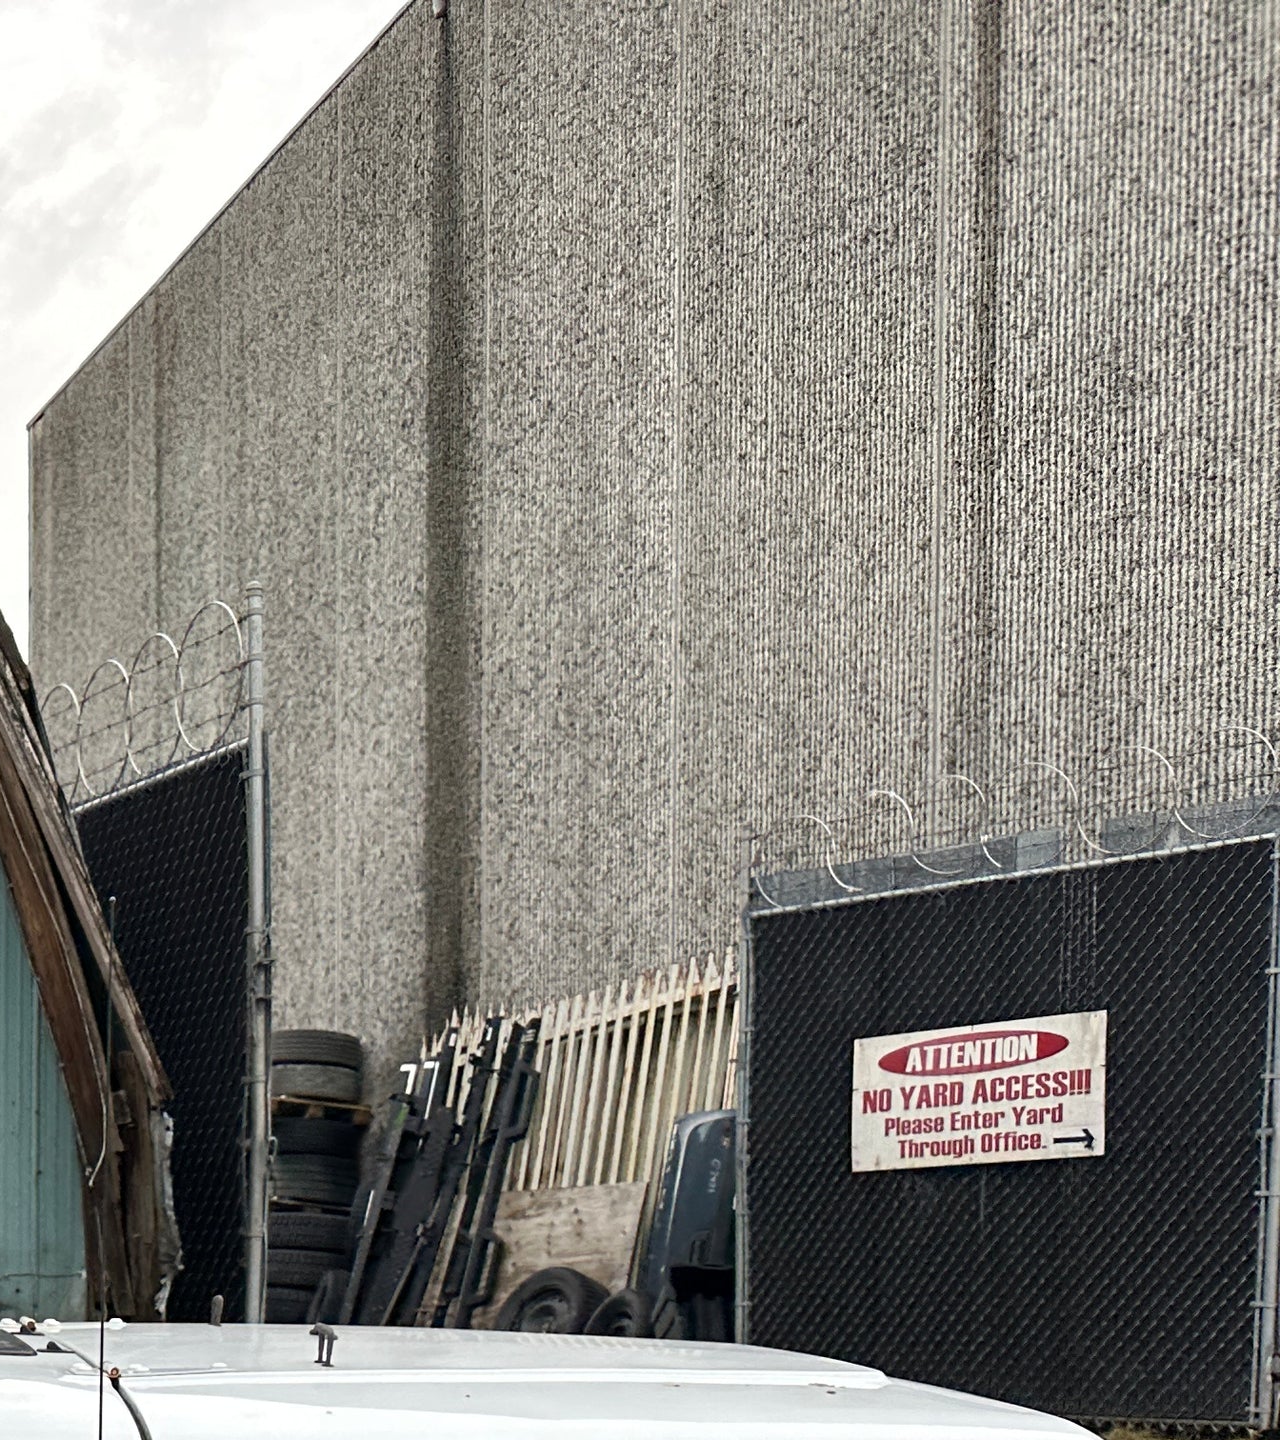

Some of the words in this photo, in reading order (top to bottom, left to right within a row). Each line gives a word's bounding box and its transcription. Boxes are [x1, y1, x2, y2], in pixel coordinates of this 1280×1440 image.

[904, 1033, 1039, 1073] ATTENTION
[861, 1087, 891, 1114] NO
[900, 1081, 965, 1110] YARD
[970, 1068, 1092, 1106] ACCESS!!!
[884, 1115, 945, 1138] Please
[949, 1110, 1006, 1132] Enter
[1011, 1102, 1064, 1127] Yard
[897, 1134, 975, 1160] Through
[980, 1131, 1047, 1153] Office.
